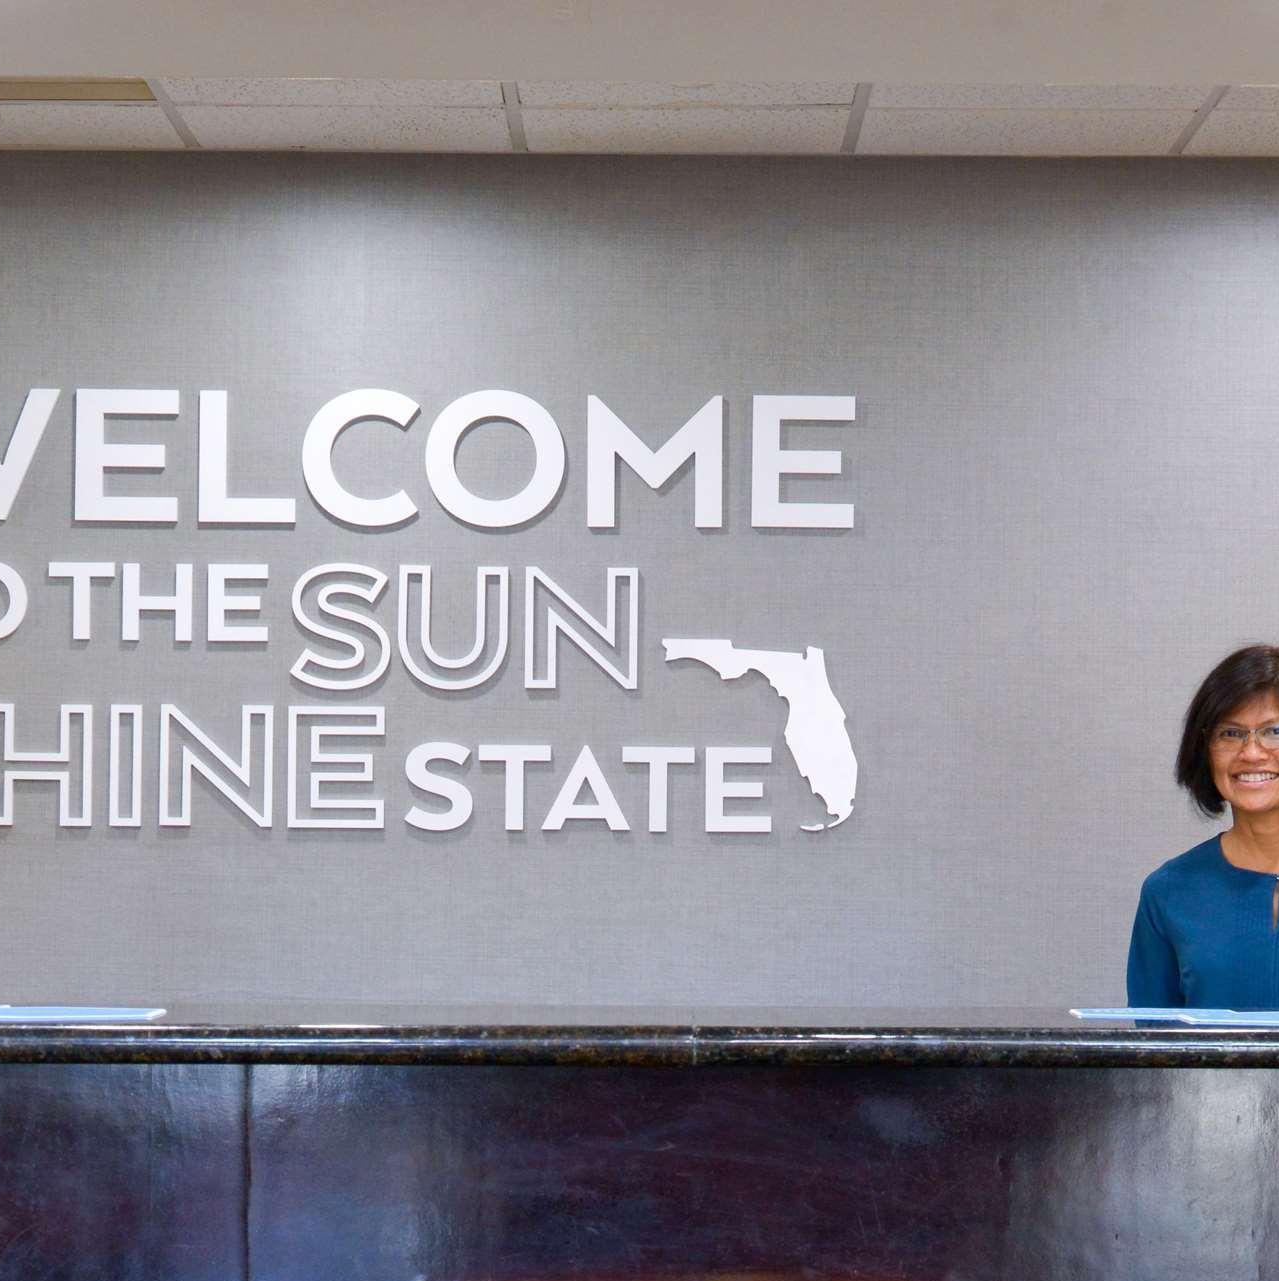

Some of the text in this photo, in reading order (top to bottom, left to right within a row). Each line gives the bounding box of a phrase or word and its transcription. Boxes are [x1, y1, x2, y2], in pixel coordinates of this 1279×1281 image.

[48, 560, 269, 643] THE
[289, 562, 640, 692] SUN
[402, 739, 773, 833] STATE
